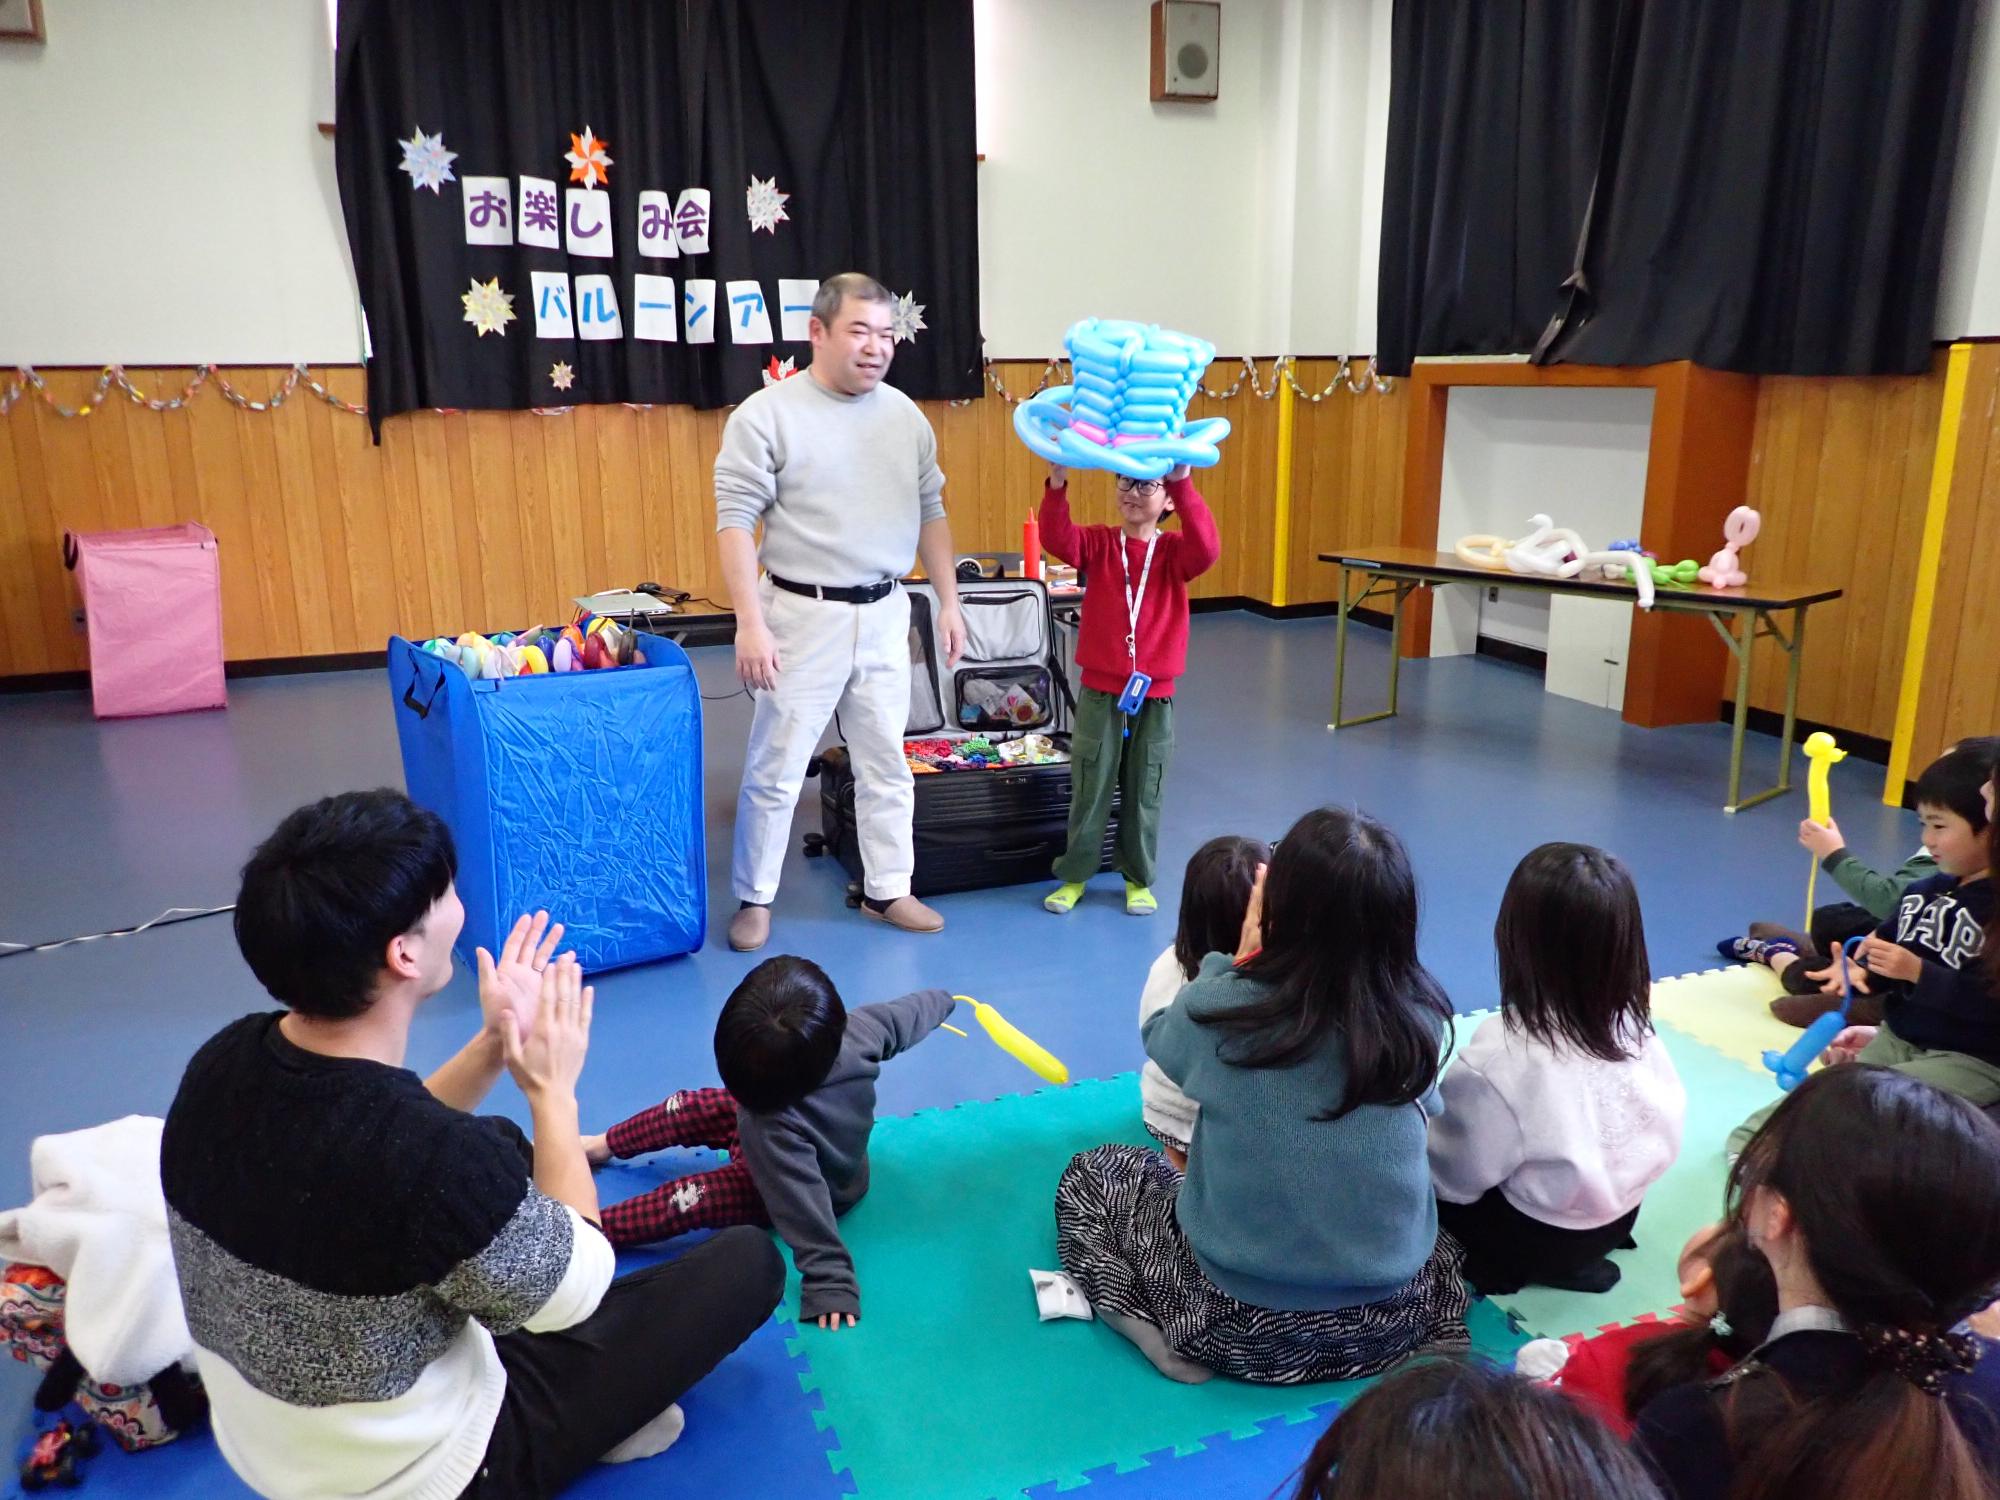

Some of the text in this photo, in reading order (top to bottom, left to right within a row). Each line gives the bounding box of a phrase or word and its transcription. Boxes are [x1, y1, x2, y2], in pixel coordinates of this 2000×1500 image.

[469, 190, 707, 240] お楽しみ会
[1896, 894, 1986, 970] GAP
